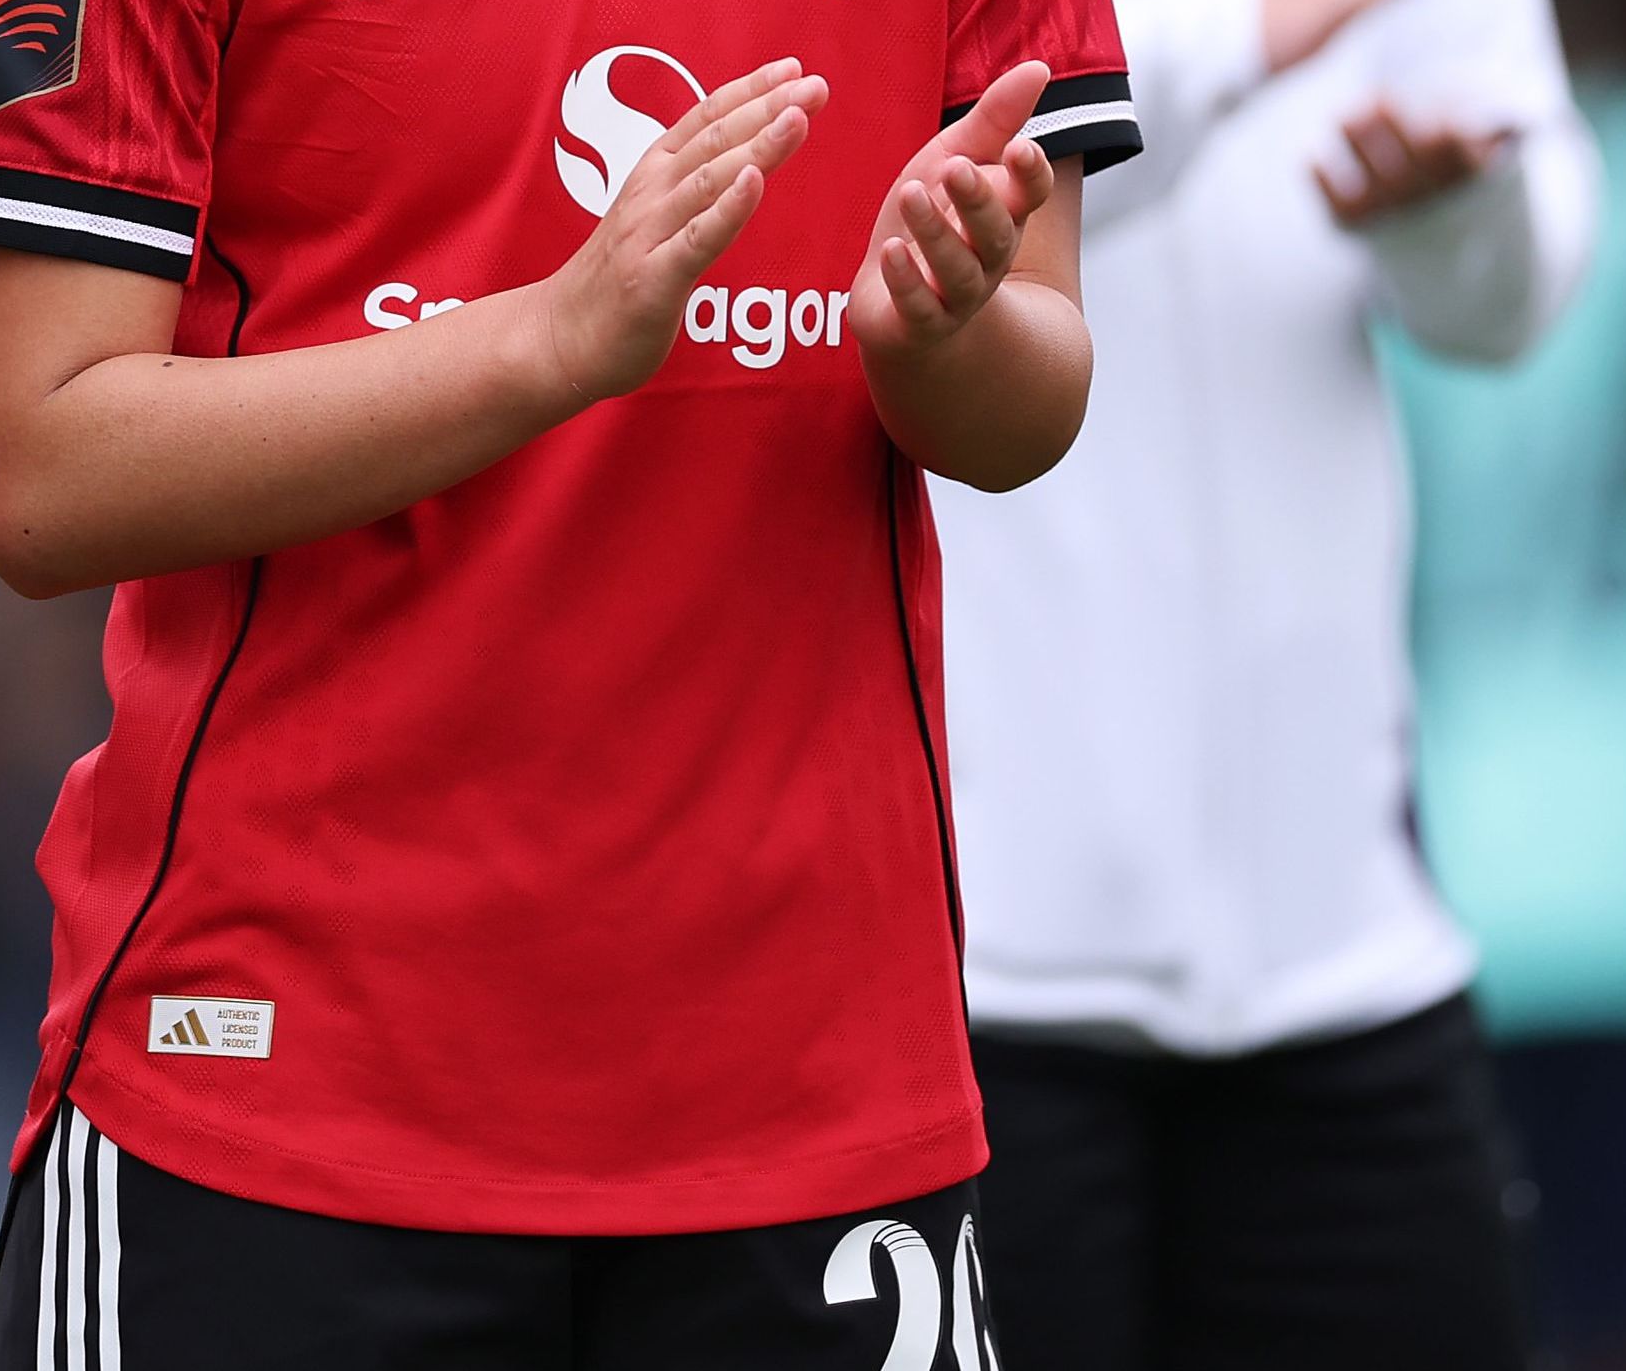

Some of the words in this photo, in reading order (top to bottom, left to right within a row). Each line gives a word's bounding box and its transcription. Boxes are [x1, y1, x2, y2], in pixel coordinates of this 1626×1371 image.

[217, 1009, 260, 1021] AUTHENTIC
[222, 1023, 258, 1035] LICENSED
[222, 1038, 257, 1049] PRODUCT
